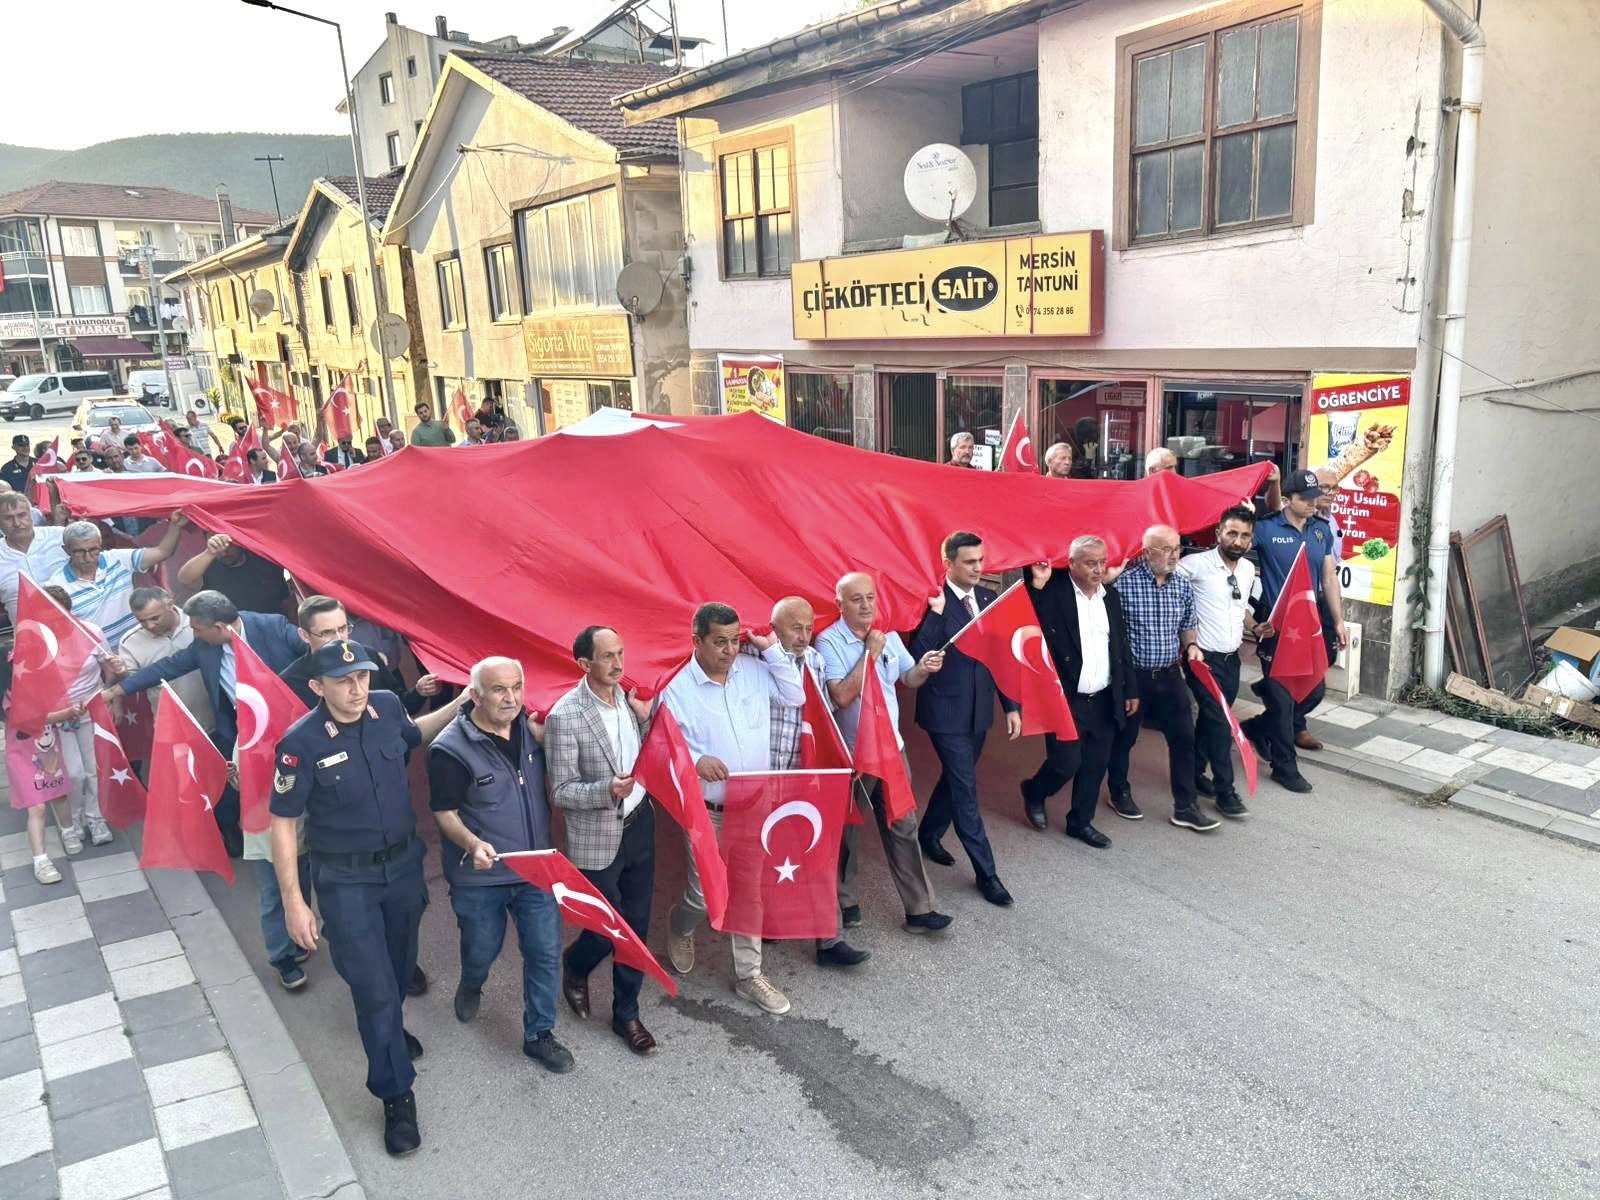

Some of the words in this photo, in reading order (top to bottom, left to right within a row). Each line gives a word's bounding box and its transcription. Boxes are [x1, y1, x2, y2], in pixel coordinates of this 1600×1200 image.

[1019, 246, 1076, 270] MERSİN
[1016, 269, 1078, 293] TANTUNİ
[803, 273, 925, 319] ÇİĞKÖFTECİ
[938, 271, 988, 301] SAİT
[57, 325, 71, 336] ET
[76, 324, 124, 336] MARKET
[527, 332, 565, 359] Sigorta
[564, 323, 590, 352] Win
[1317, 384, 1400, 409] ÖĞRENCİYE
[1330, 502, 1370, 517] Dürüm
[1353, 491, 1388, 507] Usulü
[1341, 528, 1366, 539] yran
